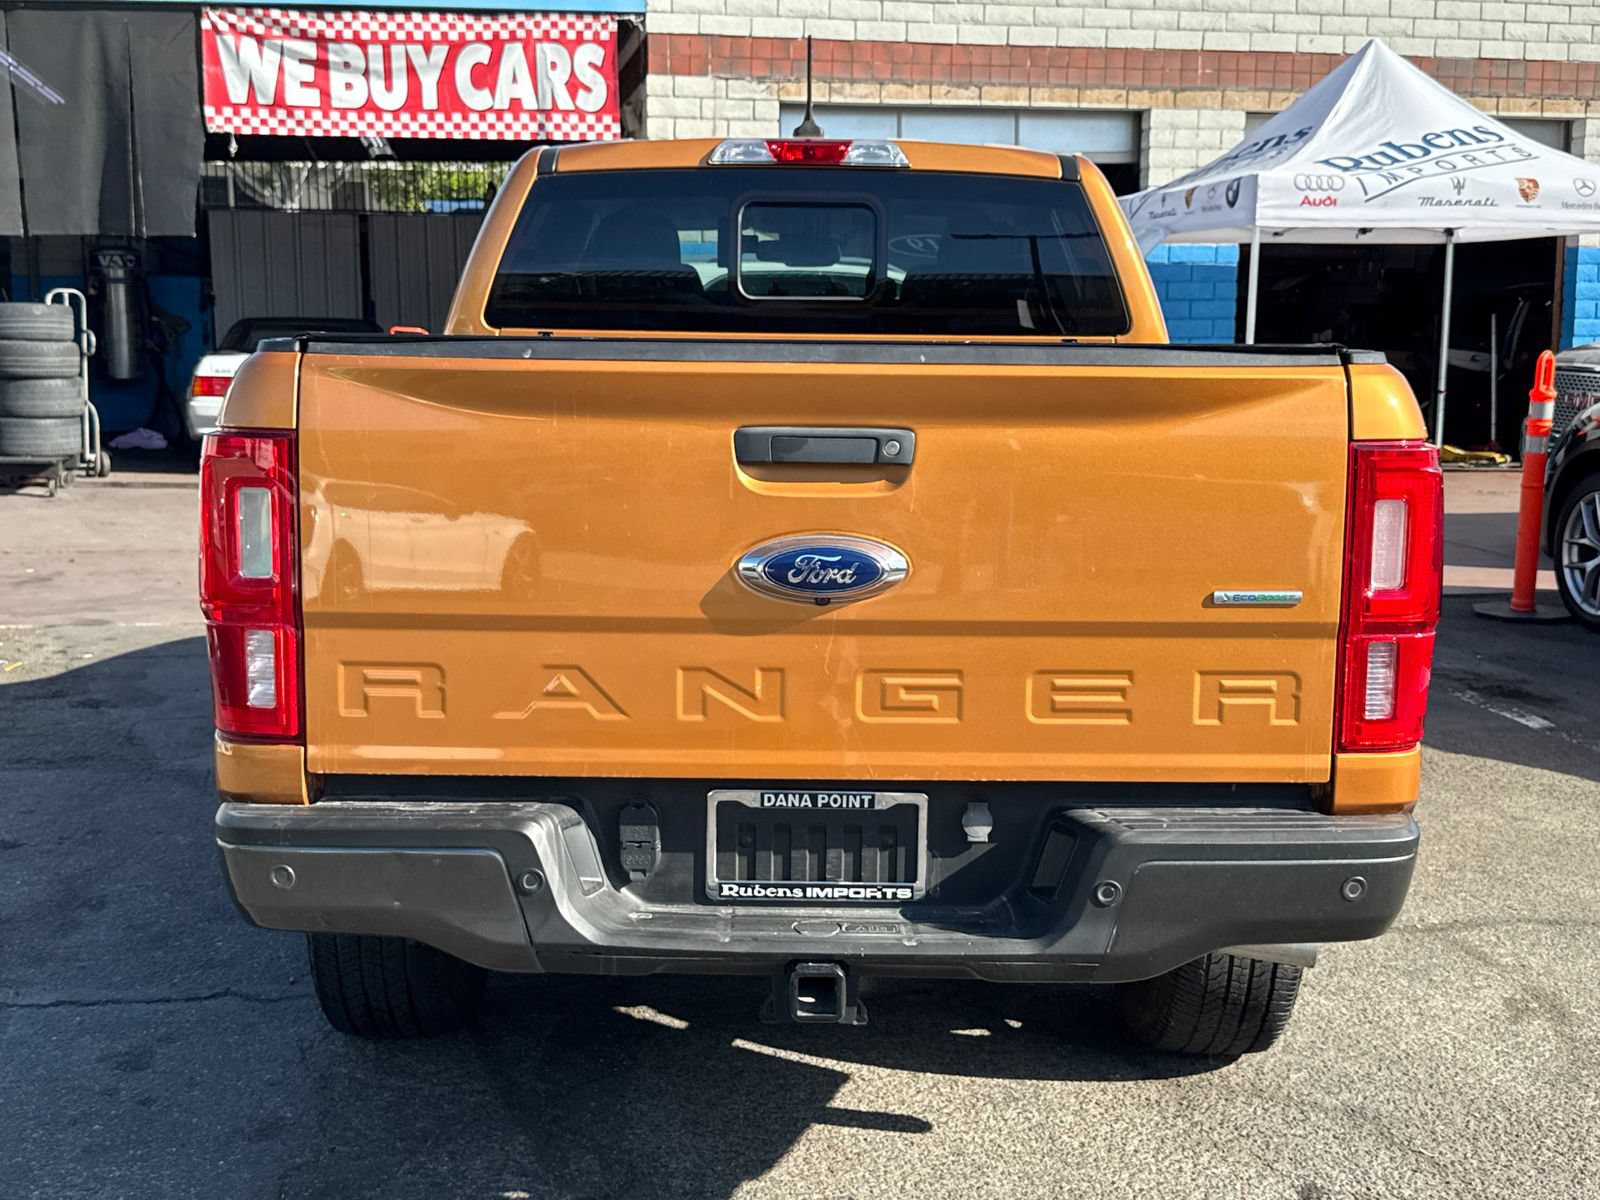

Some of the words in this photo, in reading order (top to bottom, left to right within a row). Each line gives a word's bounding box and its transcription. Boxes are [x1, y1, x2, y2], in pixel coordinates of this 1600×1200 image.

[215, 34, 321, 108] WE
[330, 43, 449, 111] BUY
[454, 42, 609, 112] CARS
[1313, 124, 1506, 174] Rubens
[1356, 146, 1532, 196] IMPORTS
[1299, 194, 1338, 208] Audi
[1418, 196, 1499, 208] Maserati
[787, 554, 858, 584] Ford
[337, 661, 1303, 728] RANGER
[763, 793, 812, 808] DANA
[817, 794, 872, 809] POINT
[720, 883, 804, 897] Rubens
[805, 886, 913, 899] IMPORTS
